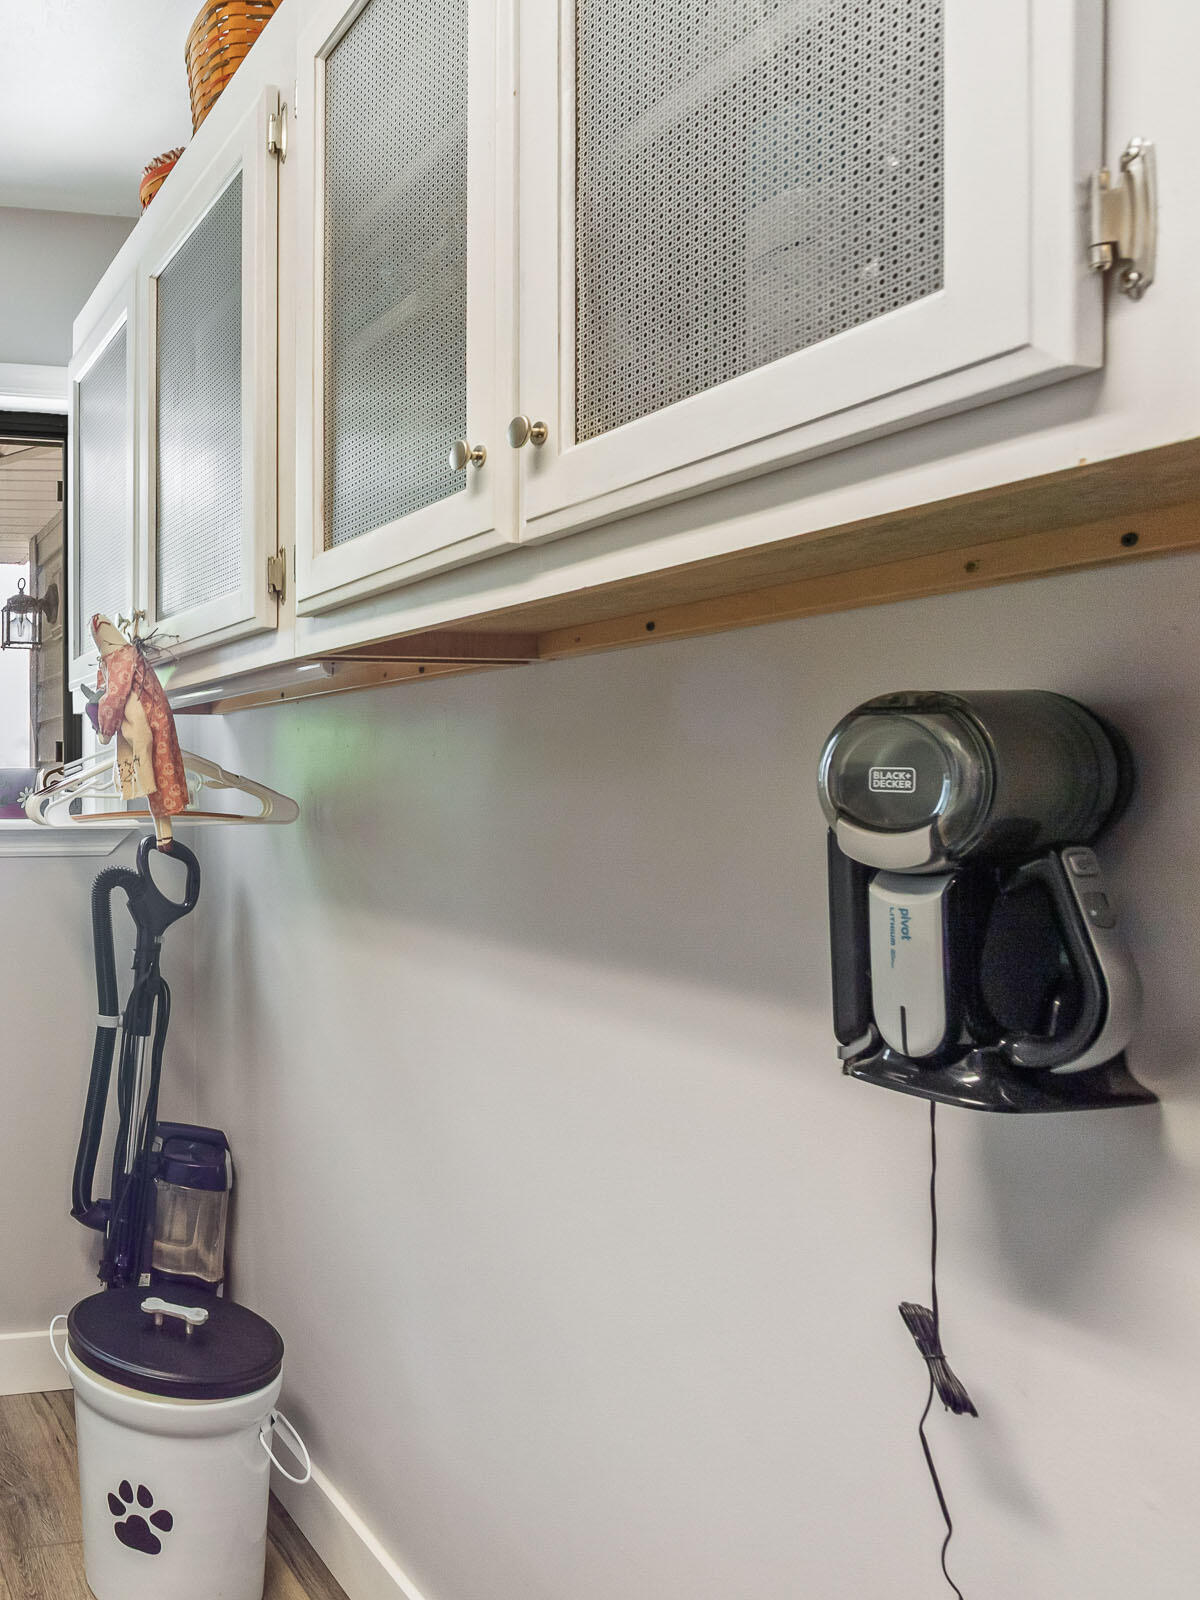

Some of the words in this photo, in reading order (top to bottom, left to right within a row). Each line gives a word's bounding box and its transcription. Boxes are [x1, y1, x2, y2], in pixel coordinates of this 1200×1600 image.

[873, 771, 912, 780] BLACK+
[873, 779, 912, 788] DECKER
[898, 907, 912, 941] pivot
